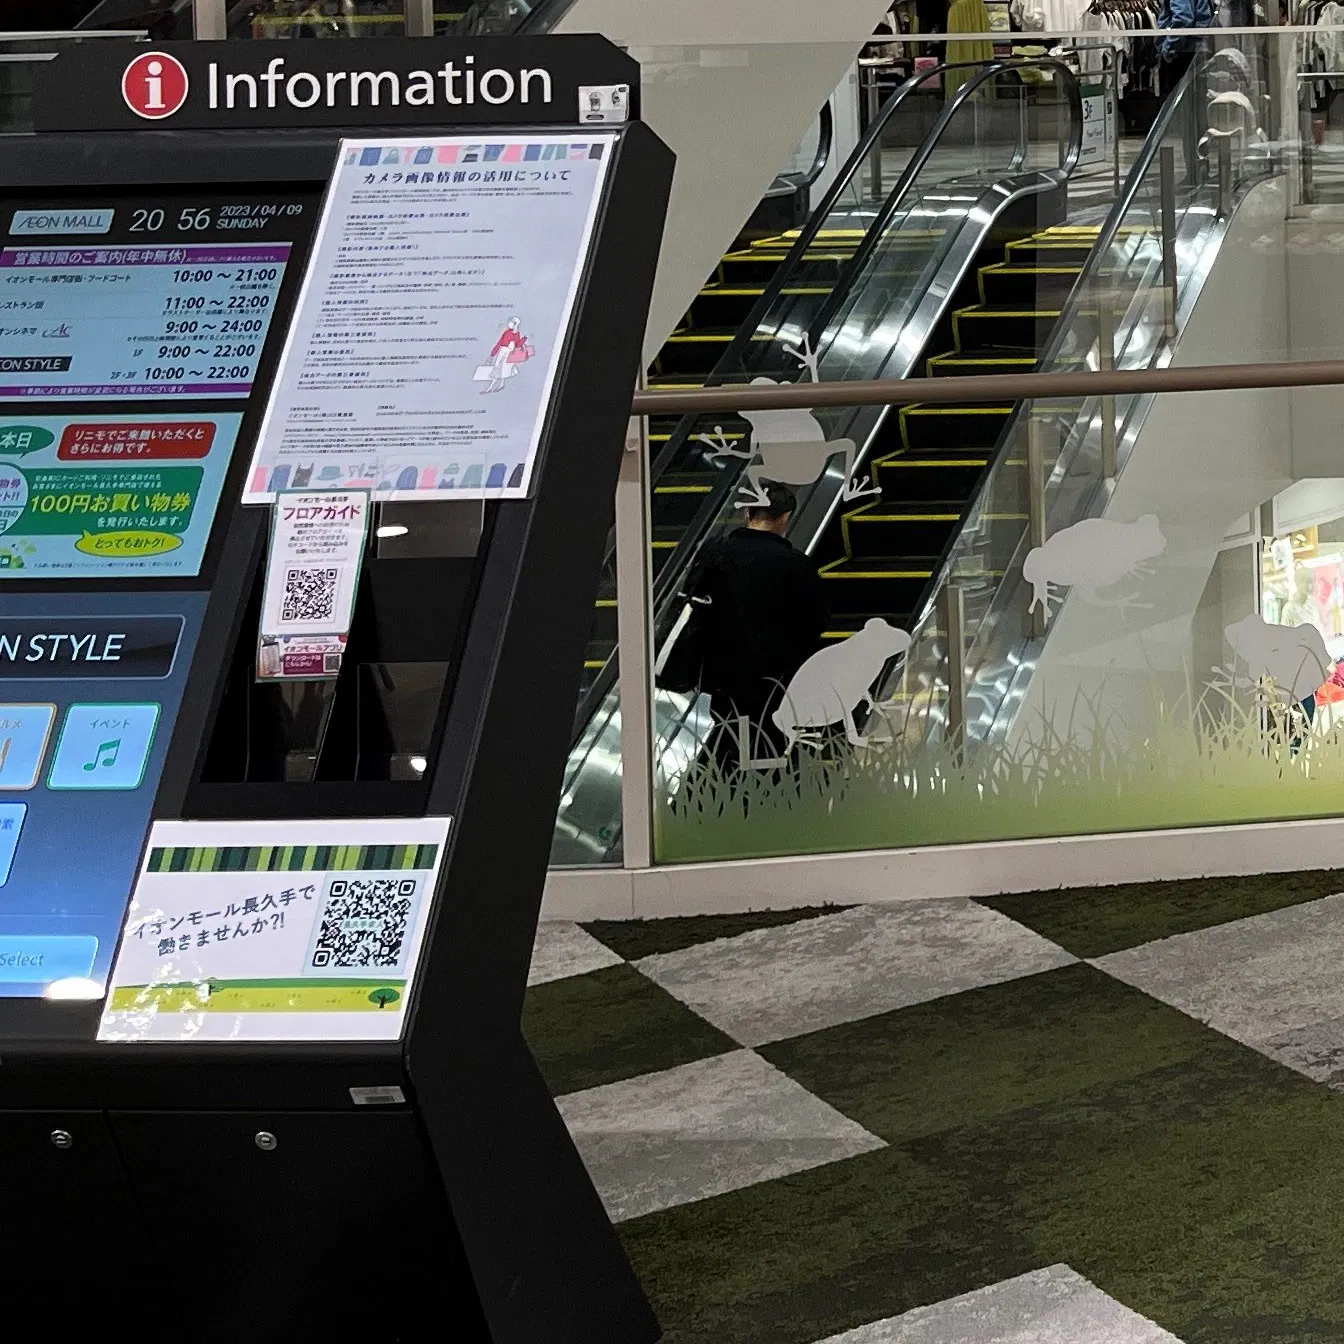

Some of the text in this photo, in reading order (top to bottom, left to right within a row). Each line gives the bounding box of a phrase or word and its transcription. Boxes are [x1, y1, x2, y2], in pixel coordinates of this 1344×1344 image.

[208, 55, 552, 110] Information
[363, 169, 572, 184] カメラ画像情報の活用について
[63, 214, 105, 227] MALL
[129, 207, 211, 232] 20 56
[216, 218, 268, 229] SUNDAY
[14, 249, 187, 265] 営業時間のご案内(年中無休)
[173, 269, 213, 282] 10:00
[235, 268, 277, 281] 21:00
[165, 296, 205, 309] 11:00
[227, 295, 270, 308] 22:00
[166, 321, 198, 334] 9:00
[221, 320, 263, 333] 24:00
[157, 345, 190, 359] 9:00
[213, 344, 256, 357] 22:00
[23, 358, 61, 369] STYLE
[144, 367, 184, 381] 10:00
[207, 366, 250, 379] 22:00
[1, 432, 32, 448] 本日
[74, 429, 205, 441] リニモでご来館いただくと
[70, 443, 152, 454] さらにお得です。
[31, 492, 191, 516] 100円お買い物券
[283, 505, 361, 521] フロアガイド
[97, 516, 183, 528] を発行いたします。
[94, 538, 166, 549] とってもおトク!
[25, 633, 126, 662] STYLE
[90, 719, 131, 729] イベント
[134, 885, 316, 939] イオンモール長久手で
